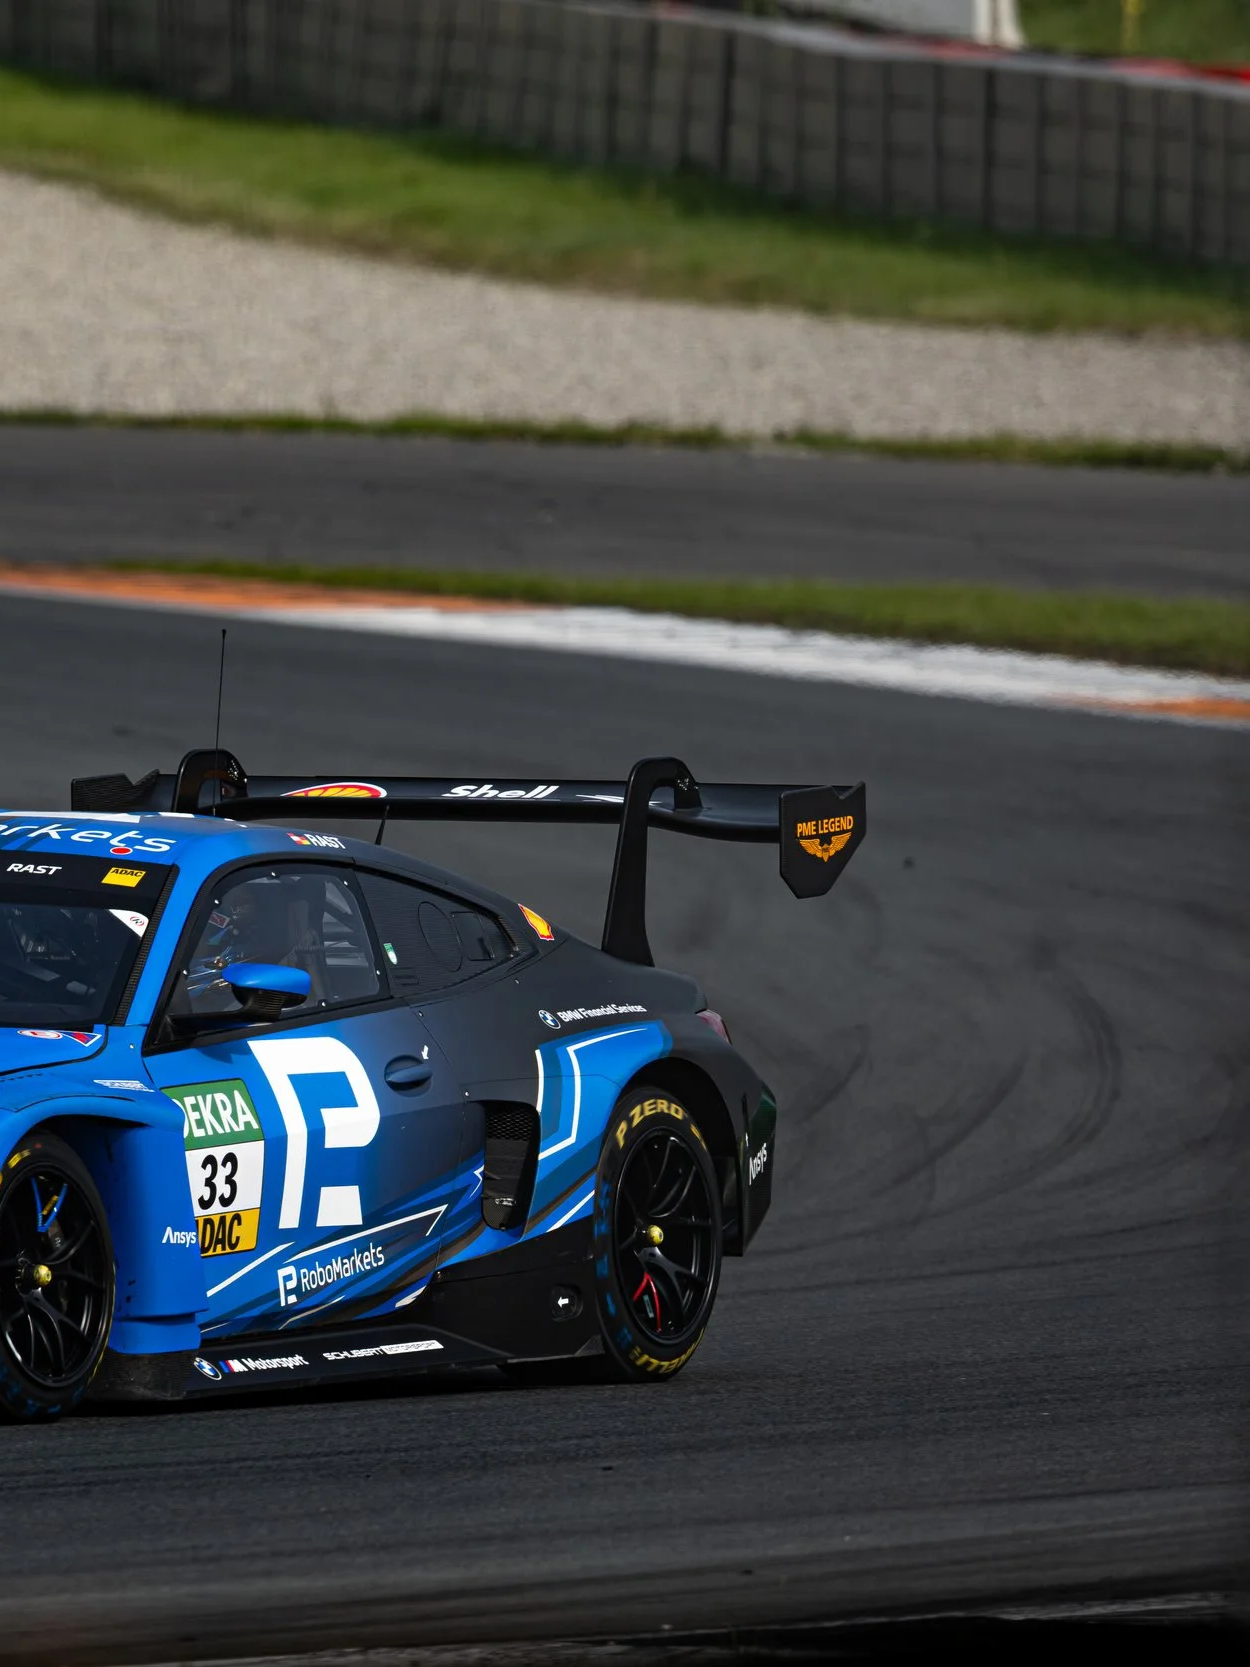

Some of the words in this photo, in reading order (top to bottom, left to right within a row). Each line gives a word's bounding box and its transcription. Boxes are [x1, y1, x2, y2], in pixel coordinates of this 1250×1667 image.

[441, 784, 559, 799] Shell
[796, 820, 816, 837] PME
[819, 815, 854, 834] LEGEND
[306, 833, 346, 850] RAST
[6, 863, 62, 876] RAST
[111, 868, 143, 877] ADAC
[557, 1009, 584, 1022] BMW
[578, 1004, 615, 1018] Financial
[611, 1003, 648, 1014] Services
[615, 1120, 629, 1150] P
[629, 1098, 685, 1129] ZERO
[198, 1151, 239, 1211] 33
[162, 1226, 197, 1248] Ansys
[301, 1242, 385, 1292] RoboMarkets
[241, 1354, 309, 1370] Motorsport
[323, 1347, 384, 1360] SCHUBERT
